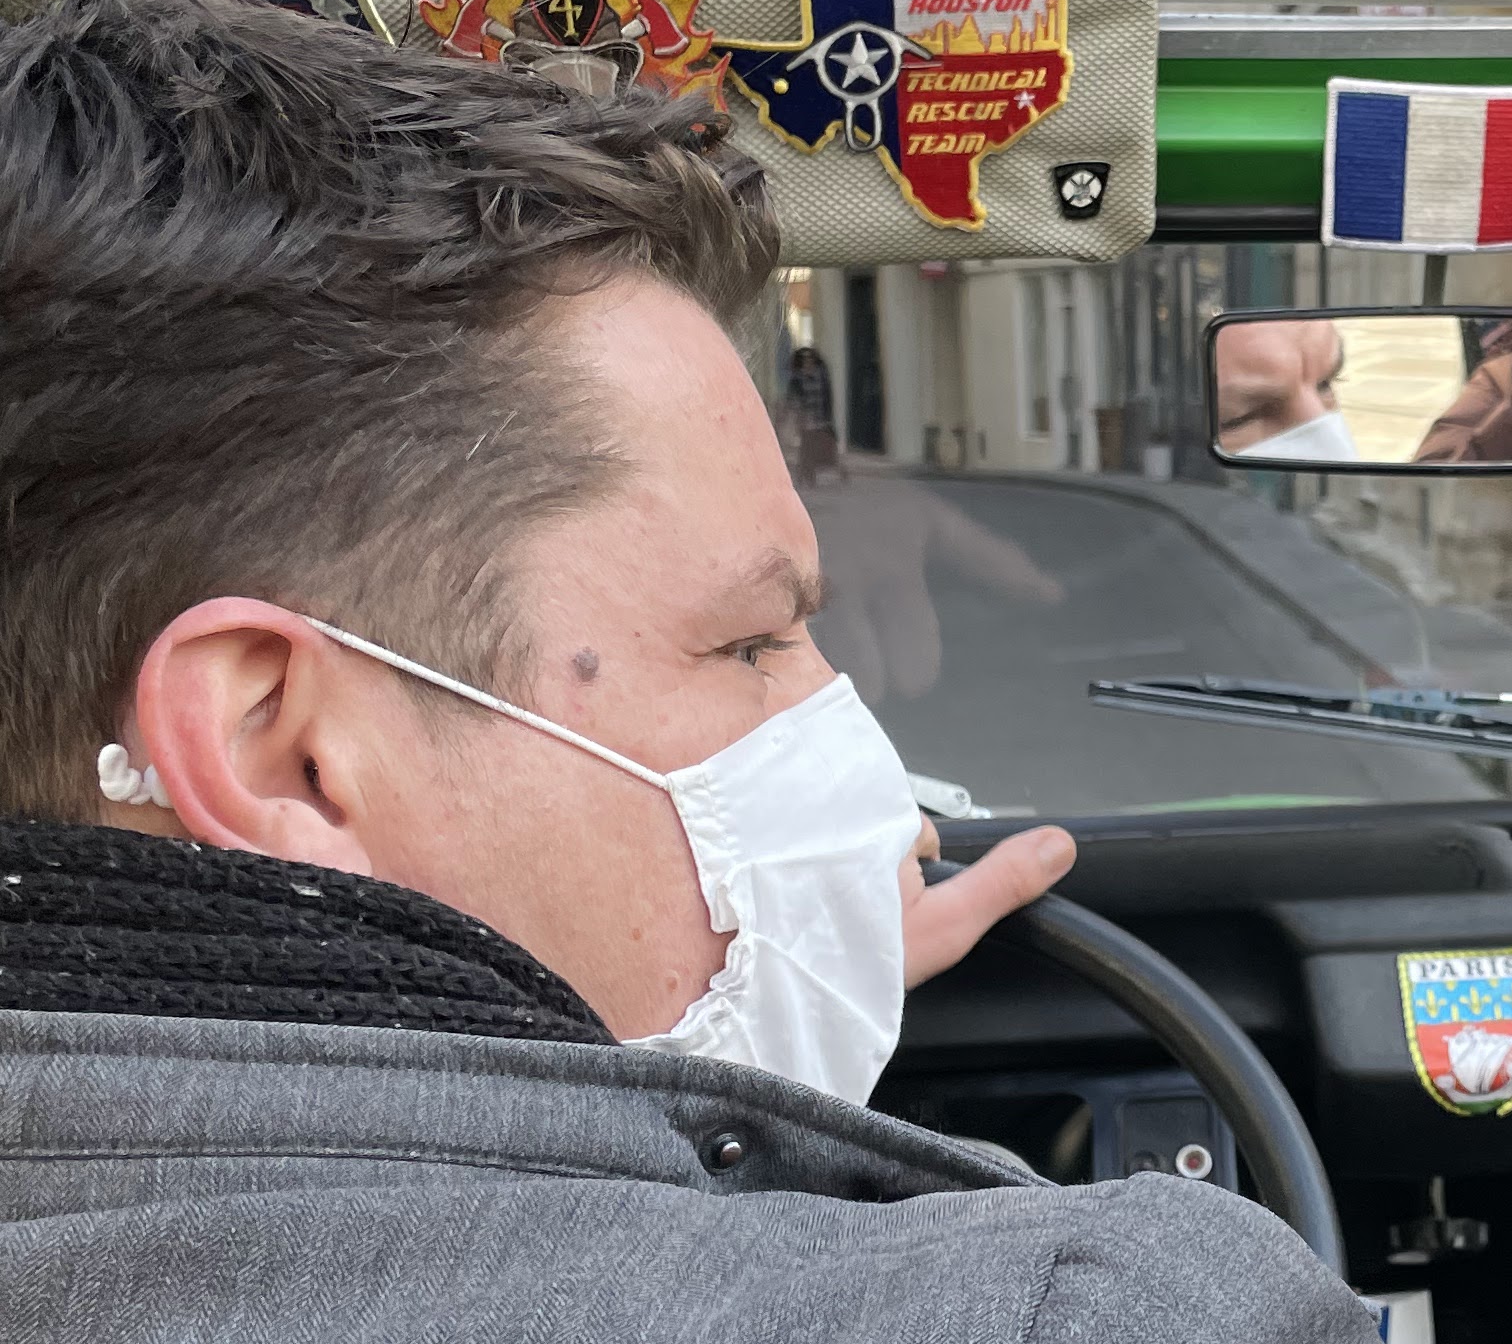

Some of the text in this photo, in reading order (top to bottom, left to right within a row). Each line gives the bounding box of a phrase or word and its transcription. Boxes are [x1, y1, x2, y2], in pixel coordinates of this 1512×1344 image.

[907, 67, 1047, 92] TECHNICAL
[906, 99, 1009, 123] RESCUE
[906, 133, 986, 156] TEAM
